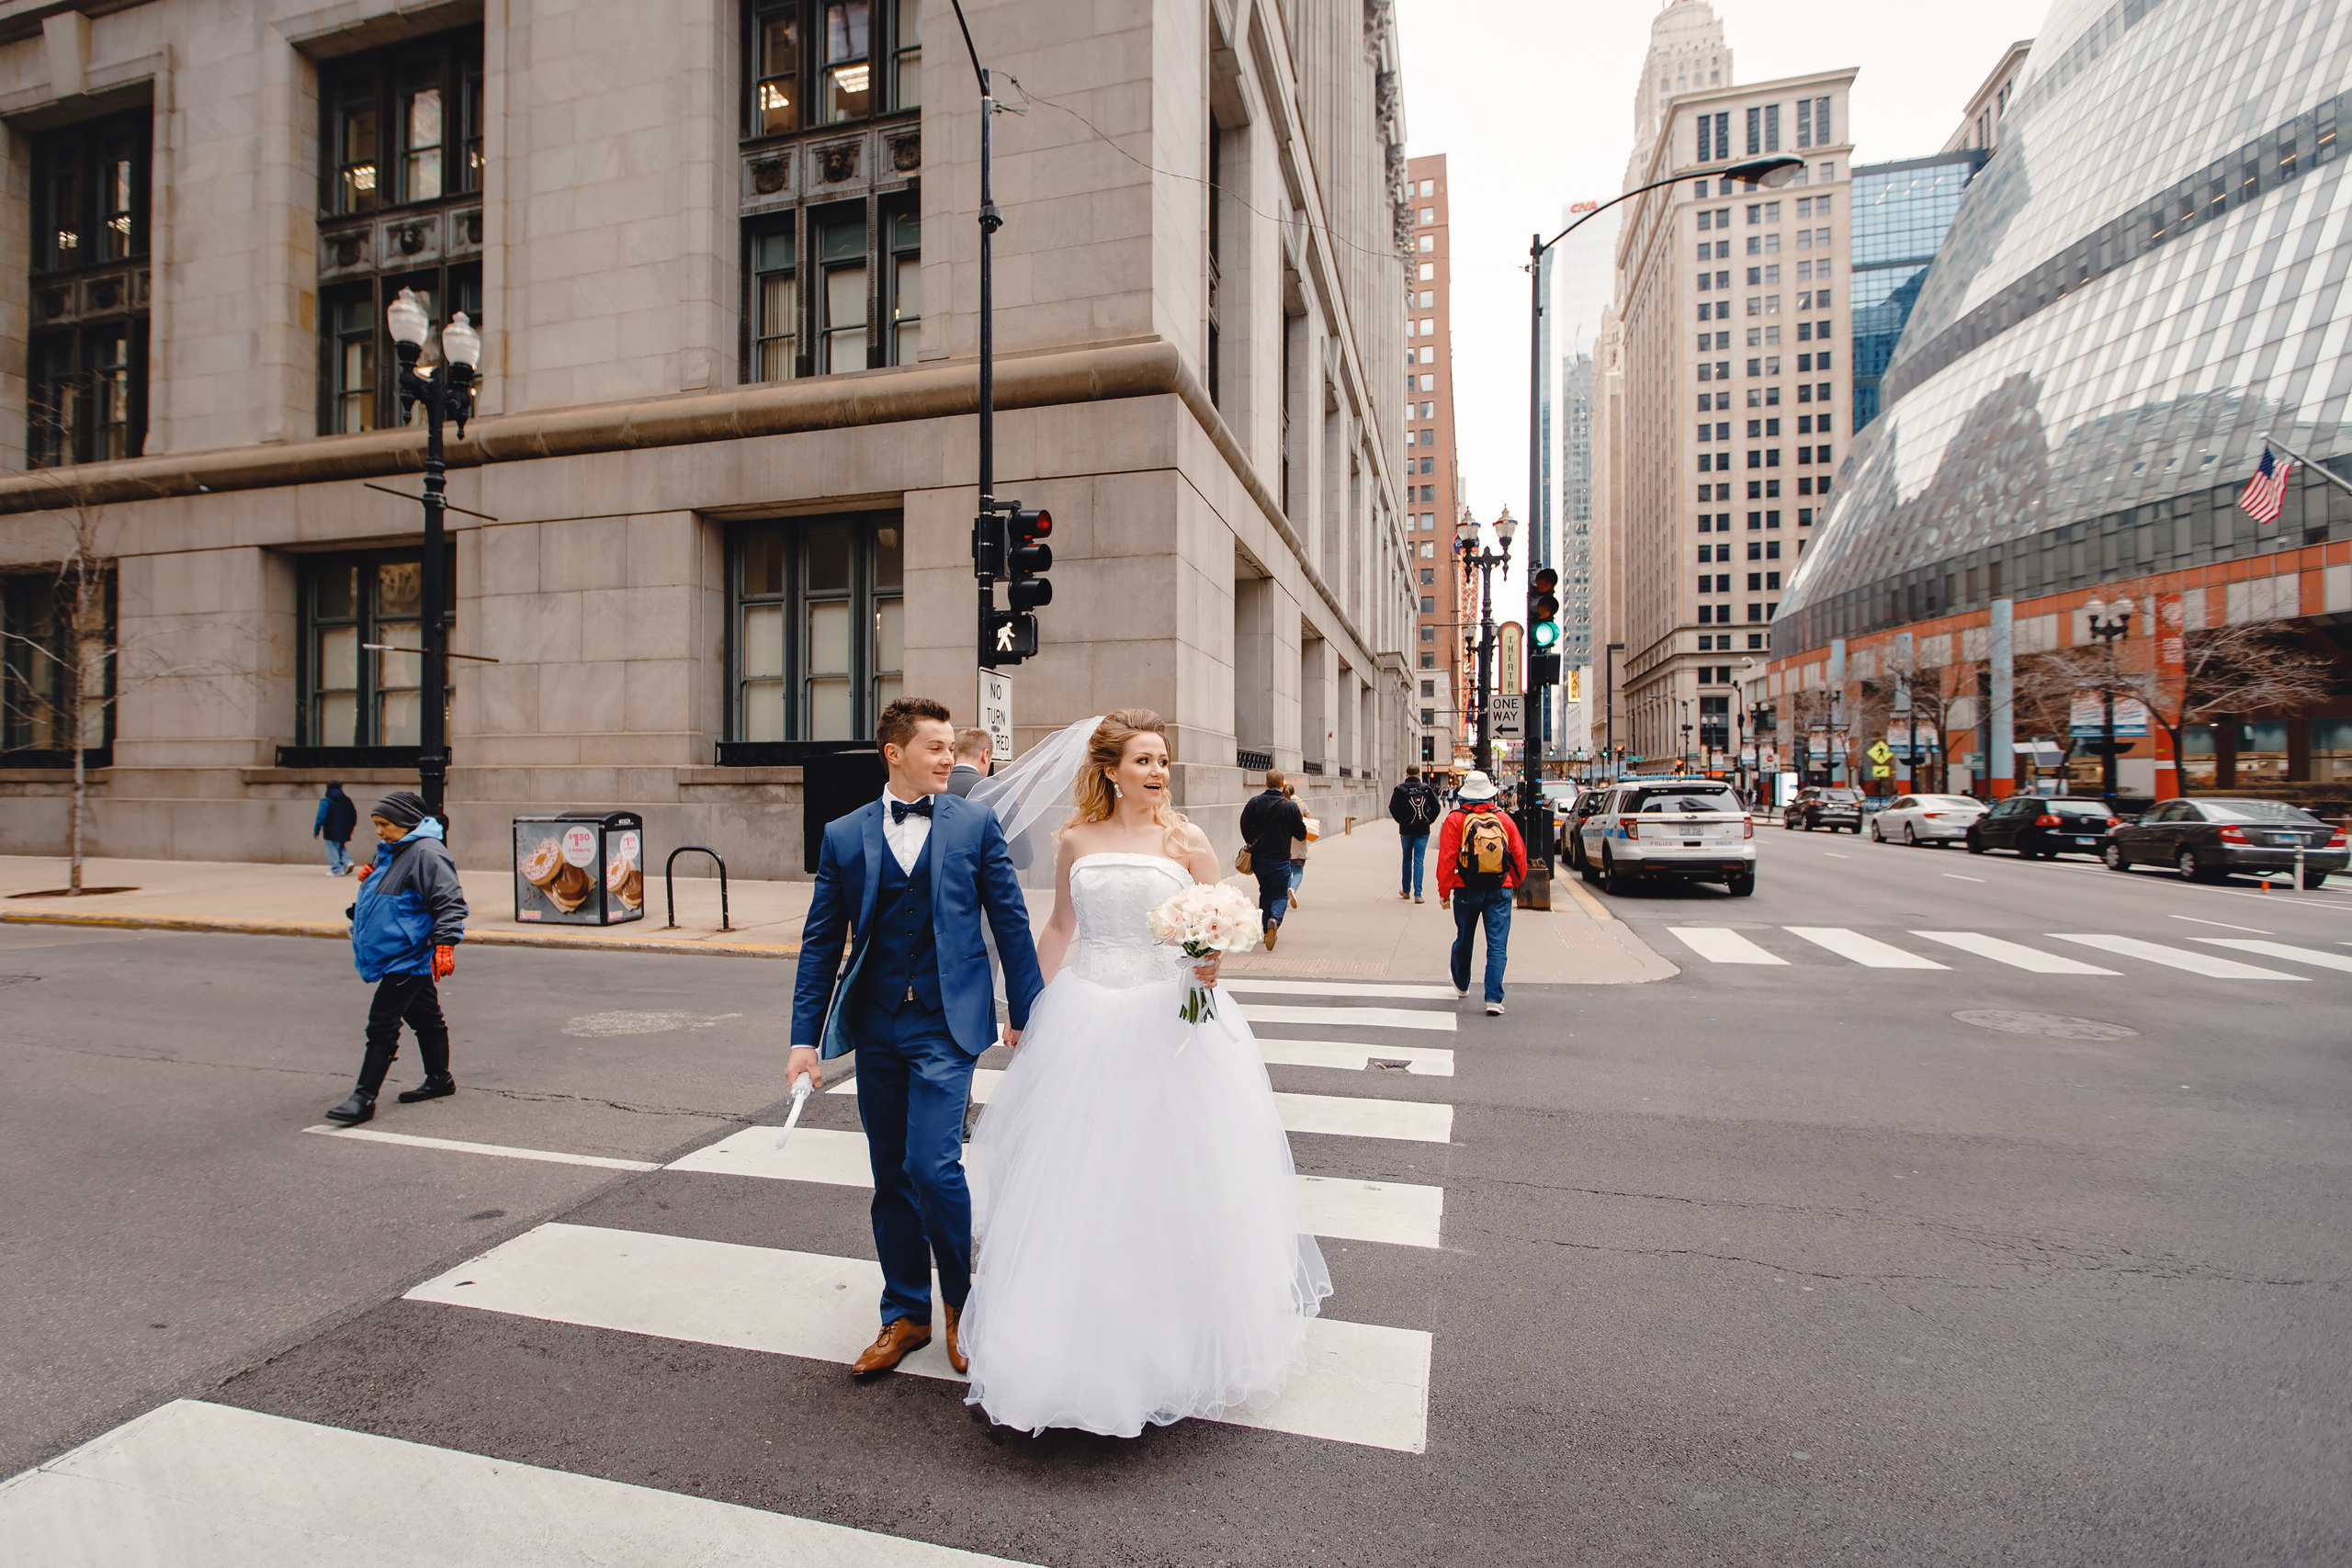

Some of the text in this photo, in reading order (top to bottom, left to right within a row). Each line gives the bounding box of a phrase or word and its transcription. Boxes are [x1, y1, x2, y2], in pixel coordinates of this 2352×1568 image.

[989, 682, 1001, 700] NO
[1493, 698, 1519, 709] ONE
[987, 707, 1005, 726] TURN
[1492, 711, 1518, 721] WAY
[996, 735, 1009, 750] RED
